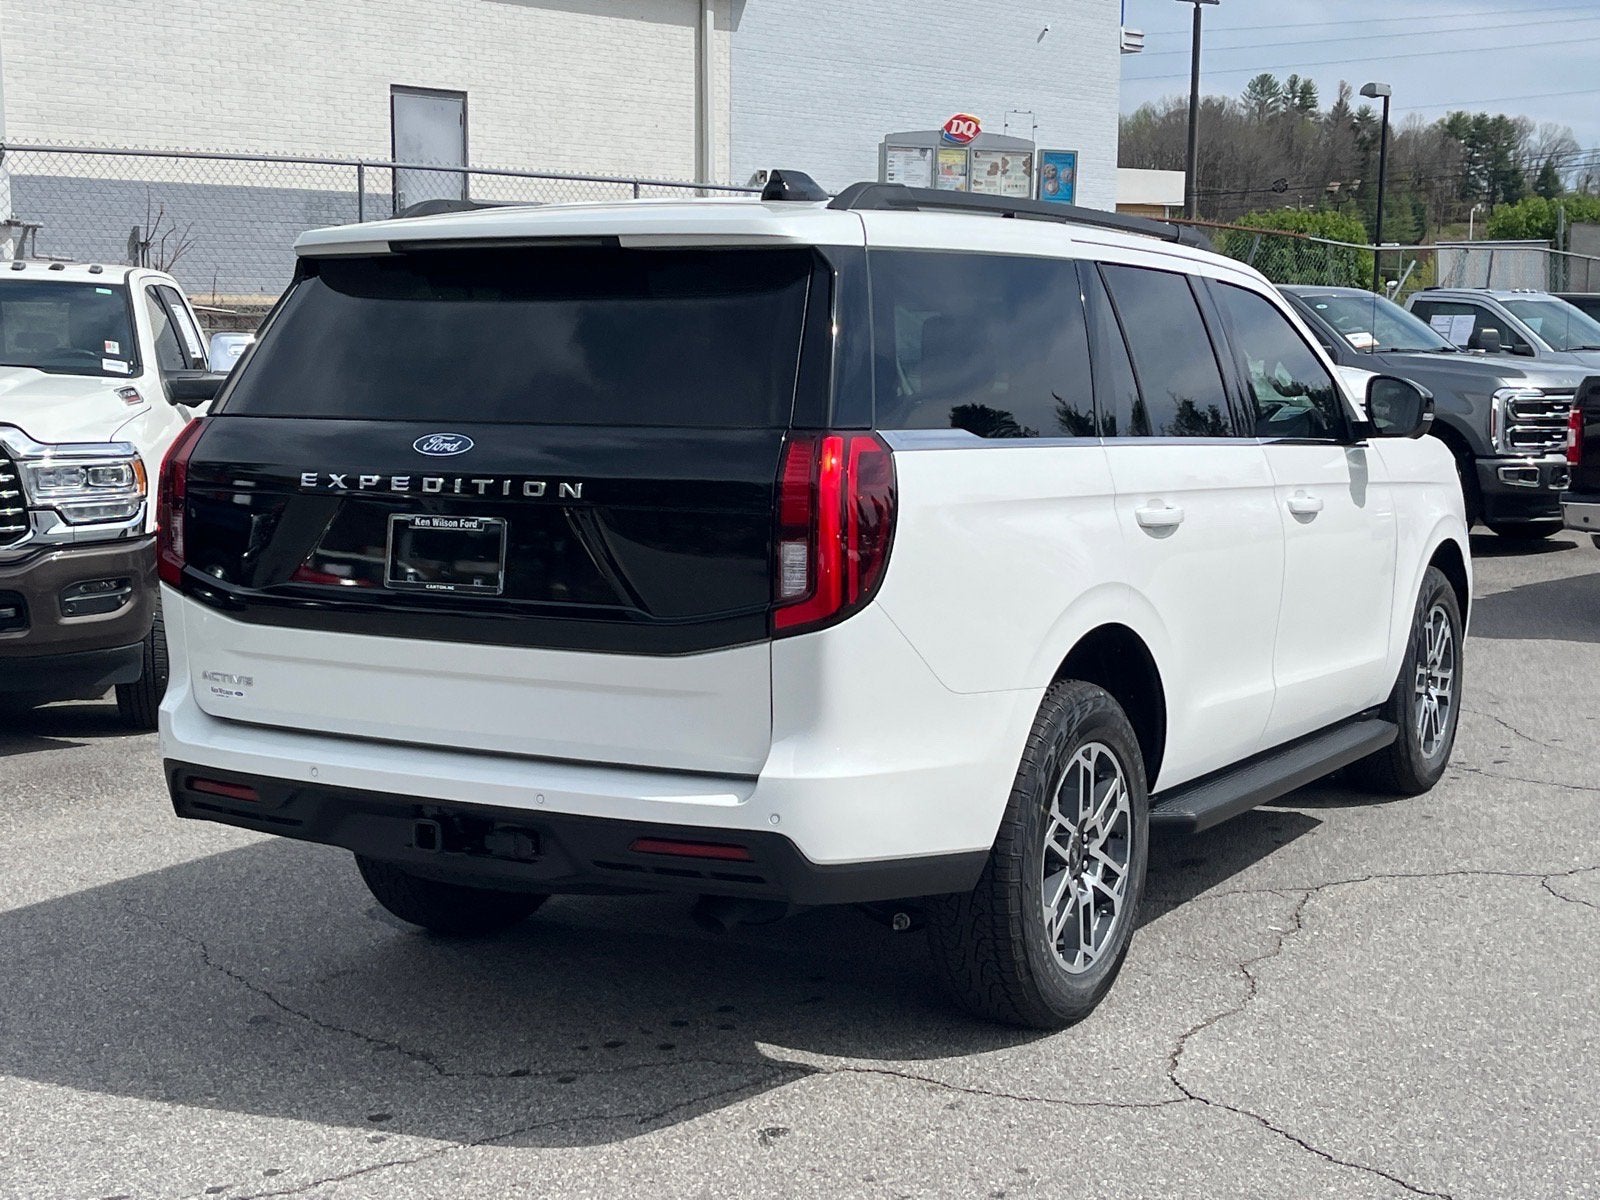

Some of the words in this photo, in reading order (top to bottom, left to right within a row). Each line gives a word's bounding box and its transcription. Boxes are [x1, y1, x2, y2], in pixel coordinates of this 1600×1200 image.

[950, 119, 977, 138] DQ
[423, 436, 462, 451] Ford
[301, 472, 583, 499] EXPEDITION
[415, 517, 430, 526] Ken
[432, 518, 458, 527] Wilson
[460, 519, 478, 528] Ford
[202, 670, 253, 686] ACTIVE
